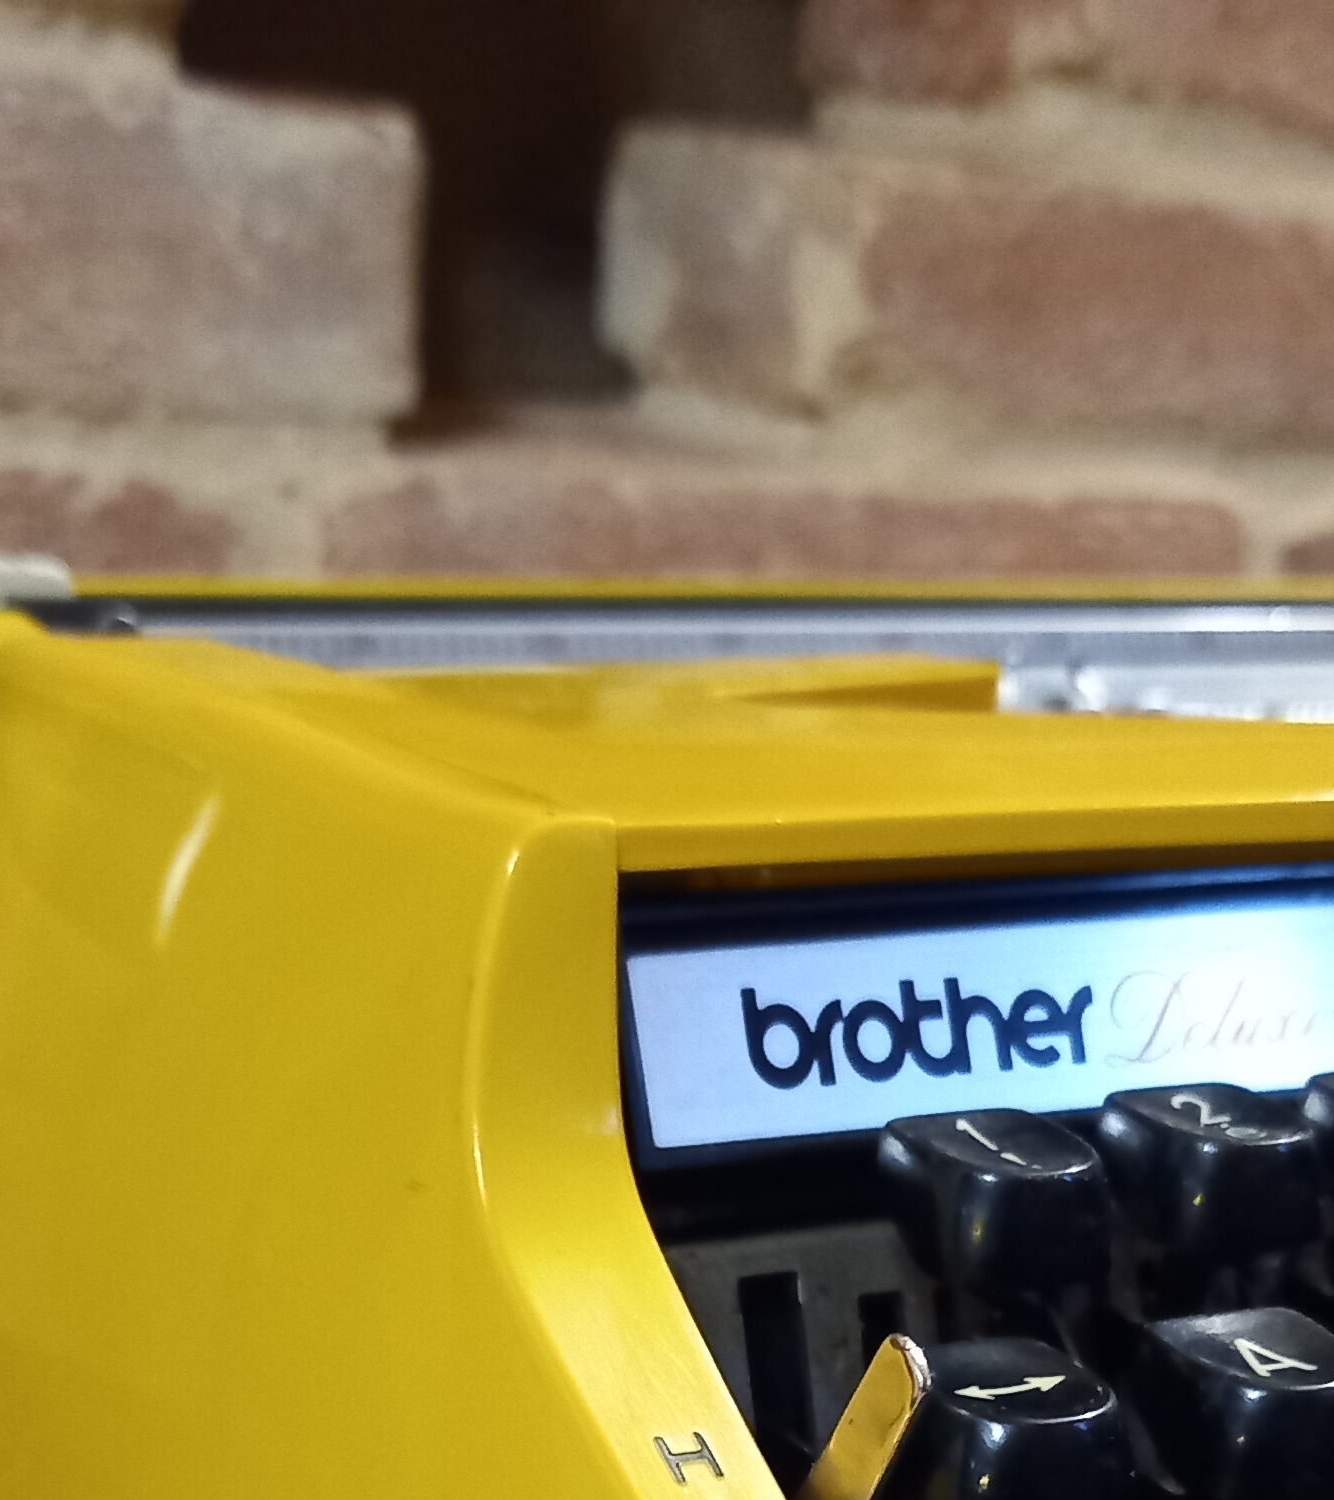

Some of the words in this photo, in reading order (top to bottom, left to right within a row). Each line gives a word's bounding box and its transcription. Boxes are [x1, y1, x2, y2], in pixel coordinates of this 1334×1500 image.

[740, 977, 1093, 1090] brother
[1171, 1092, 1232, 1127] 2
[1233, 1338, 1318, 1376] A
